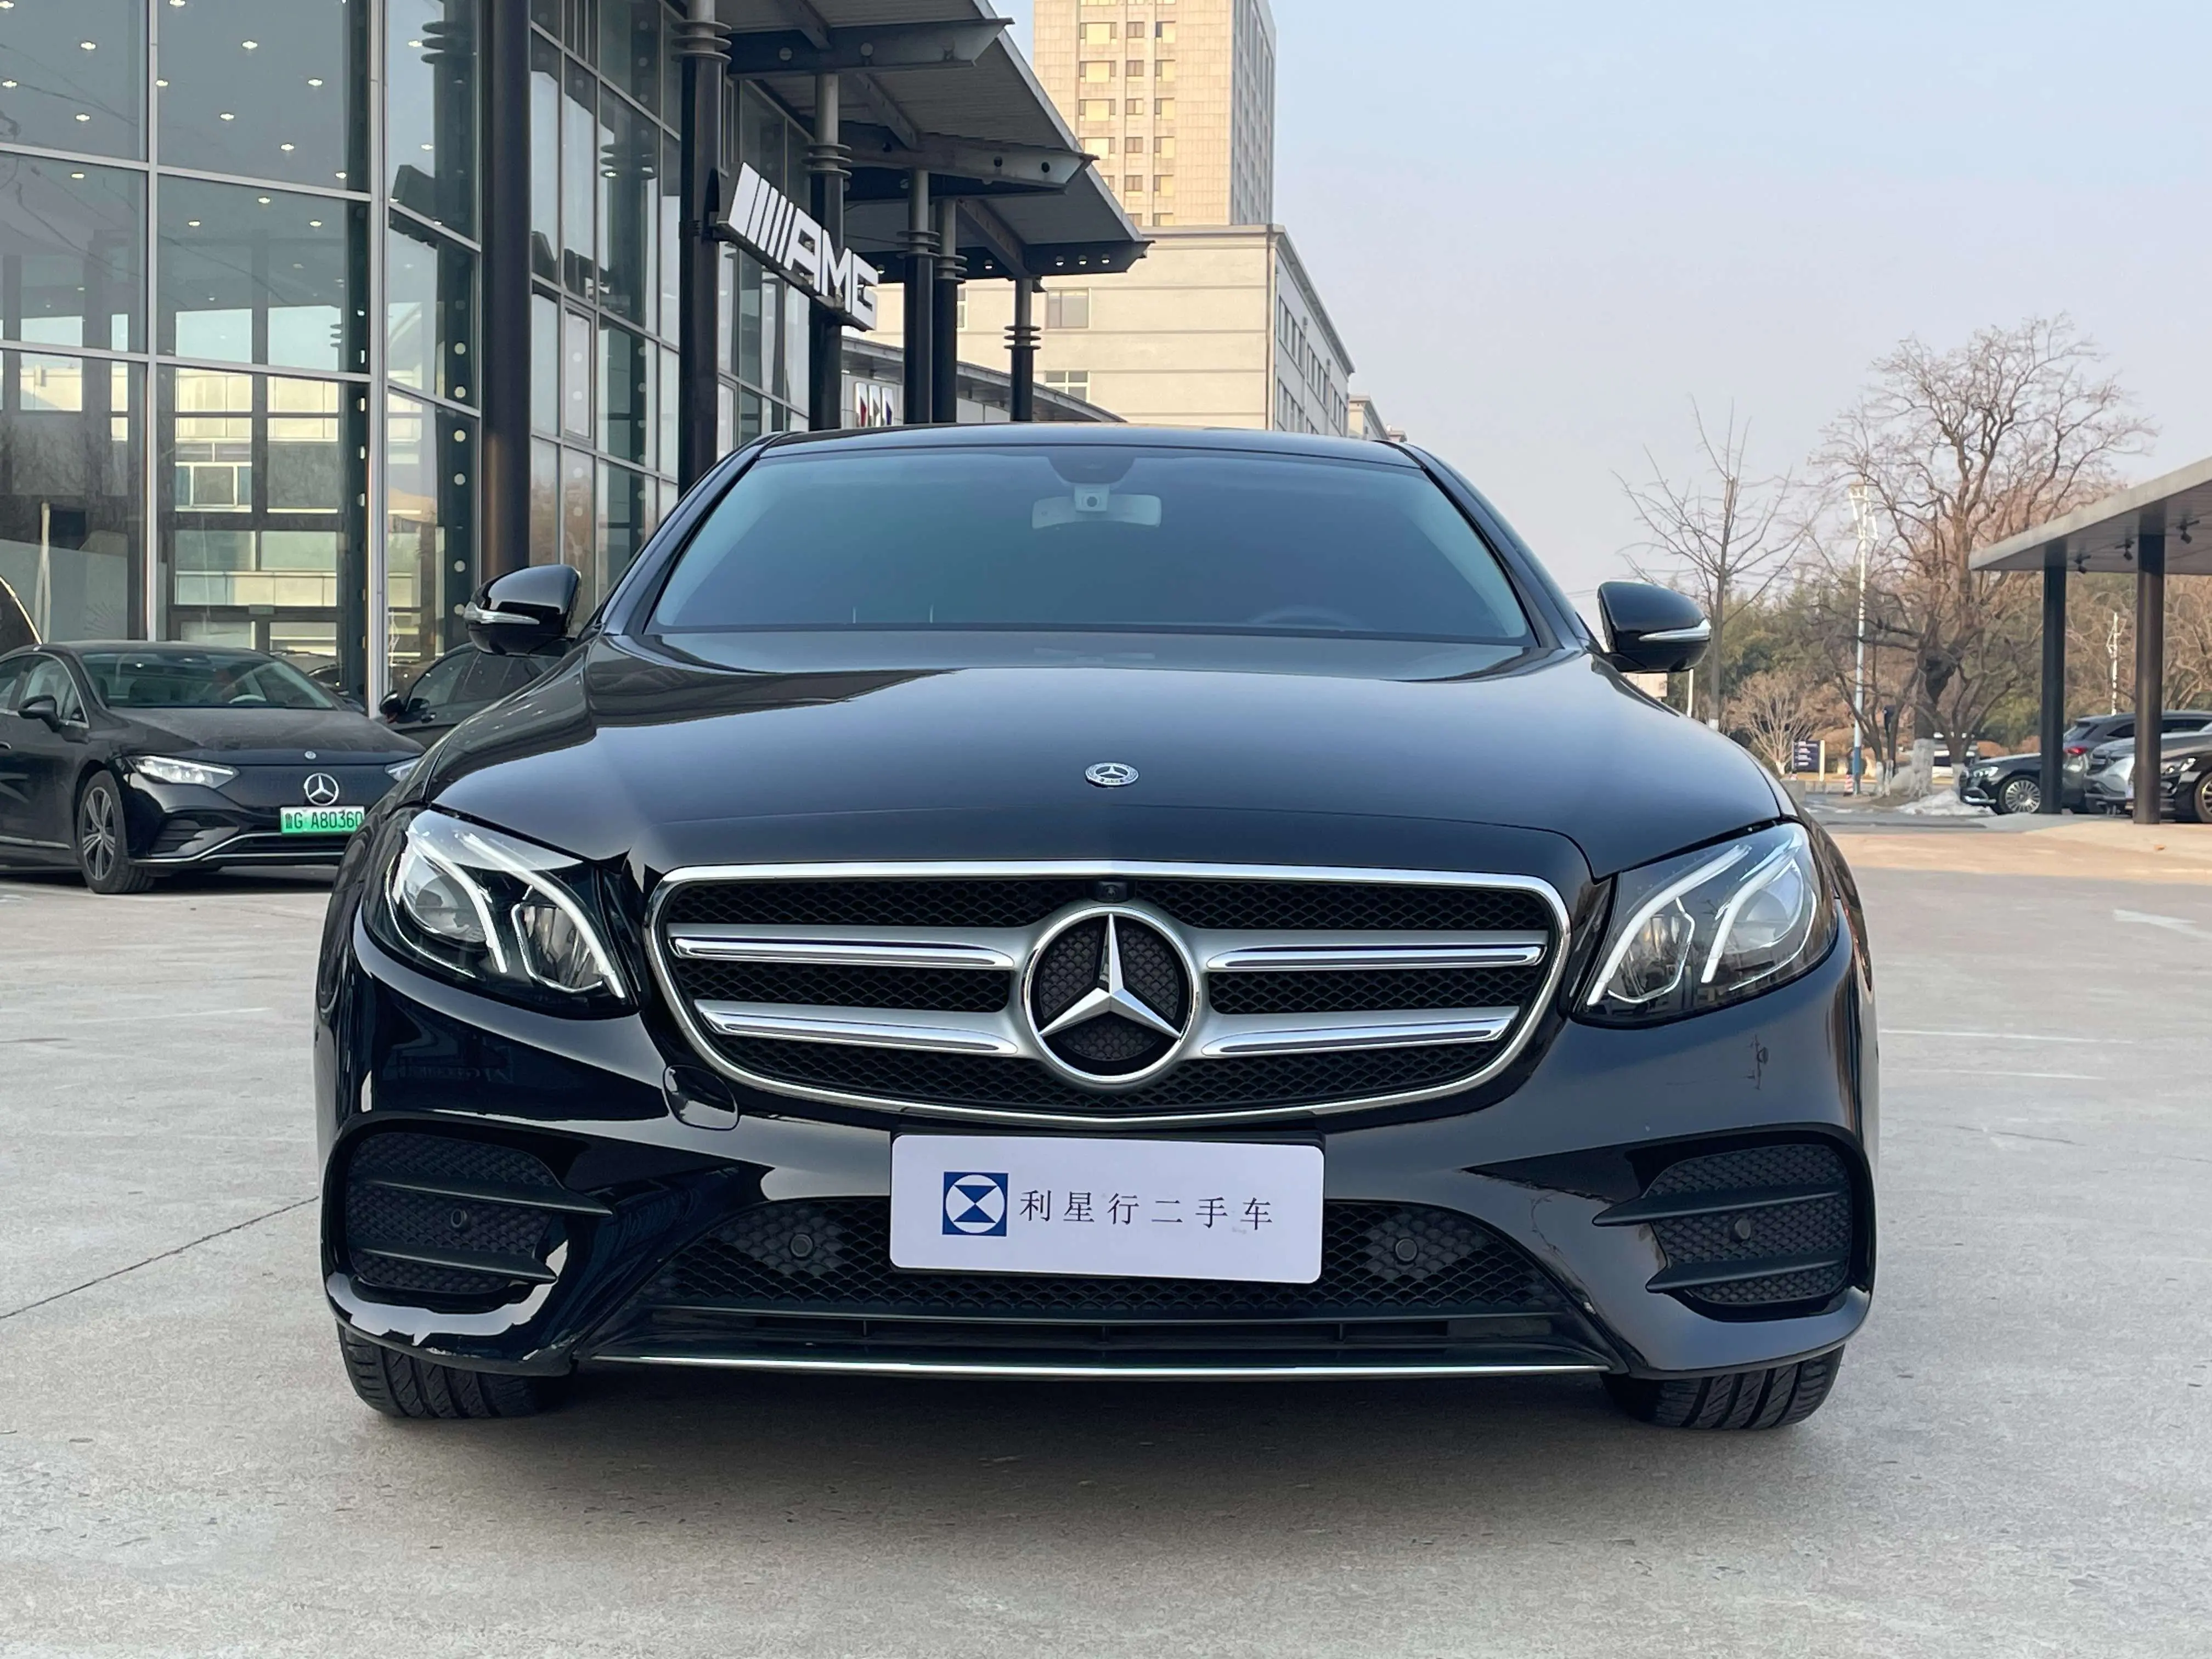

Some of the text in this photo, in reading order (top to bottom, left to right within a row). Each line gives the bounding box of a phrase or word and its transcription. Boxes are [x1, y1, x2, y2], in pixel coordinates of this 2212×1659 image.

[784, 207, 878, 330] AMG
[1020, 1189, 1273, 1230] 利星行二手车
